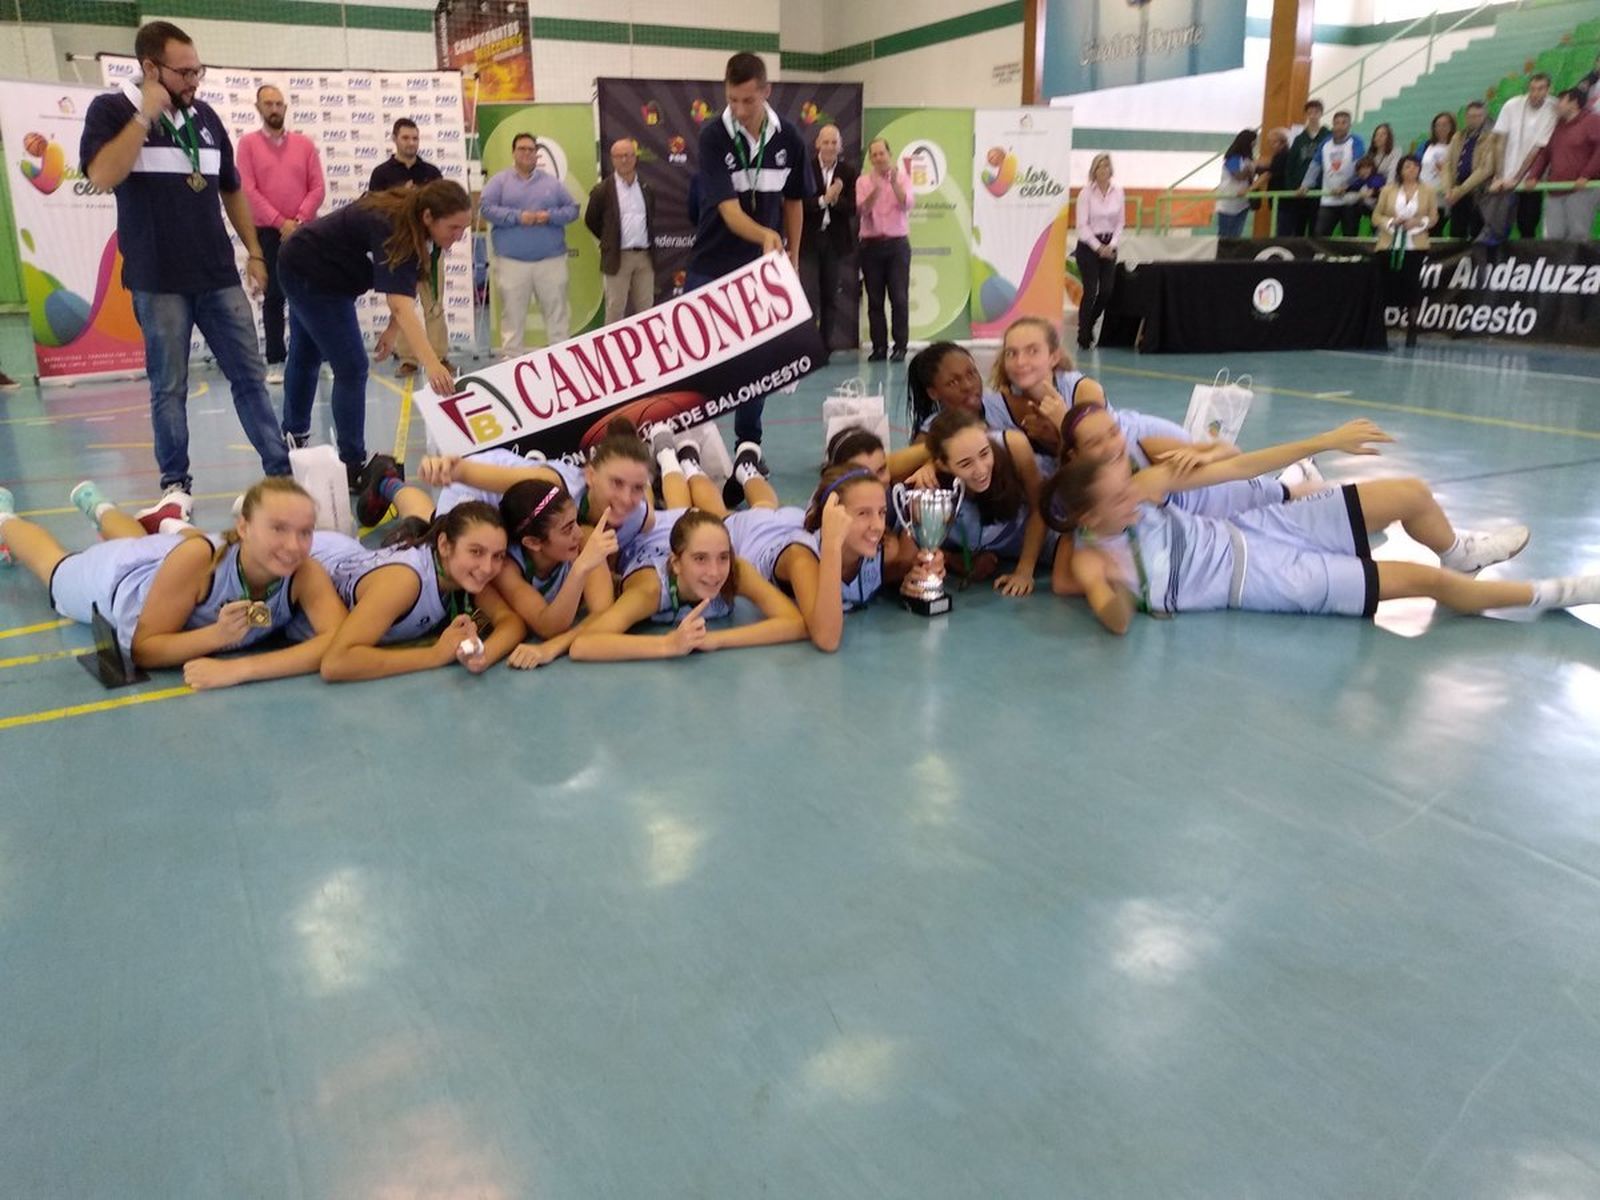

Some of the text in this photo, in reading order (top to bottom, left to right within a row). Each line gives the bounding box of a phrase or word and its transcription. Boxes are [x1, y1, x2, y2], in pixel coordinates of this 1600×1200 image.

[514, 260, 794, 420] CAMPEONES
[680, 355, 812, 427] DE BALONCESTO
